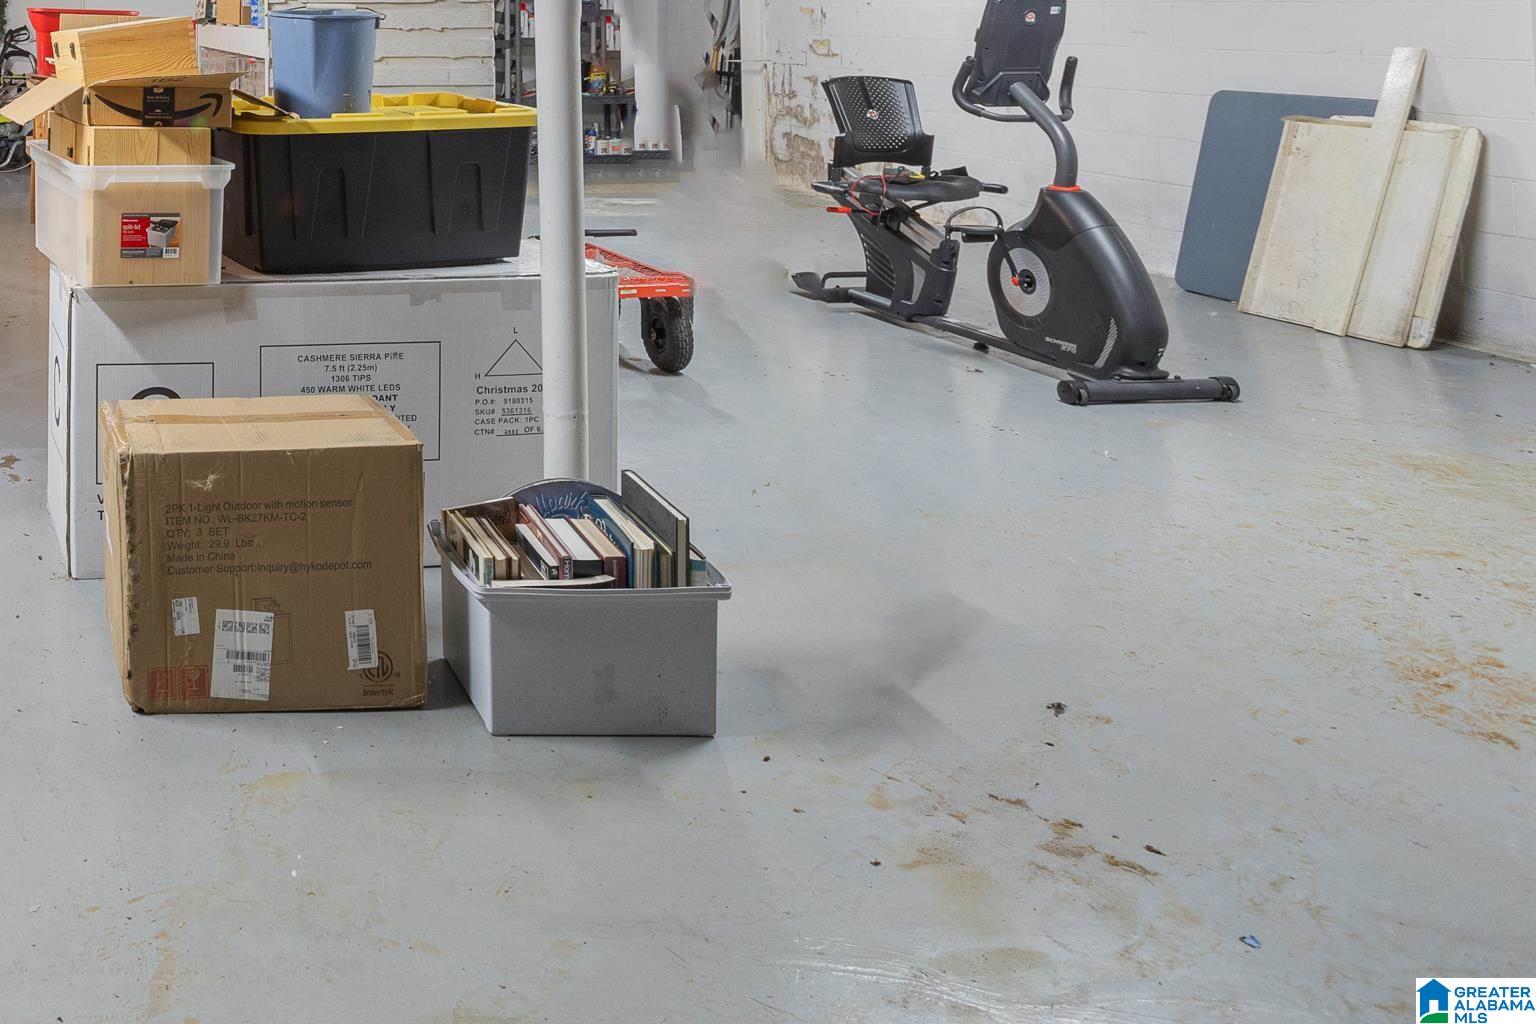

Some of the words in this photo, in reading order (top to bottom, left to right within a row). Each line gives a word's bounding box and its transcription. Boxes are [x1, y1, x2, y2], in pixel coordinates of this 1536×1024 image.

[297, 353, 347, 363] CASHMERE
[349, 352, 382, 361] SIERRA
[325, 364, 337, 372] 7.5
[339, 364, 345, 372] ft
[347, 363, 378, 373] (2.25m)
[331, 375, 350, 383] 1306
[352, 374, 372, 382] TIPS
[300, 386, 316, 394] 450
[317, 385, 346, 393] WARM
[348, 384, 376, 392] WHITE
[378, 383, 401, 391] LEDS
[476, 385, 528, 395] Christmas
[474, 408, 496, 416] SKU#
[474, 428, 495, 436] CTN#
[165, 503, 185, 514] 2PK
[189, 502, 221, 514] 1-Light
[223, 501, 261, 511] Outdoor
[264, 500, 284, 510] with
[286, 499, 317, 509] motion
[319, 499, 353, 508] sensor
[166, 516, 192, 526] ITEM
[218, 512, 308, 524] WL-BK27KM-TC-2
[166, 529, 192, 538] QTY:
[196, 528, 203, 537] 3
[208, 527, 229, 536] SET
[208, 539, 230, 548] 29.9
[167, 553, 194, 563] Made
[196, 552, 205, 562] in
[208, 551, 236, 561] China
[167, 565, 214, 576] Customer
